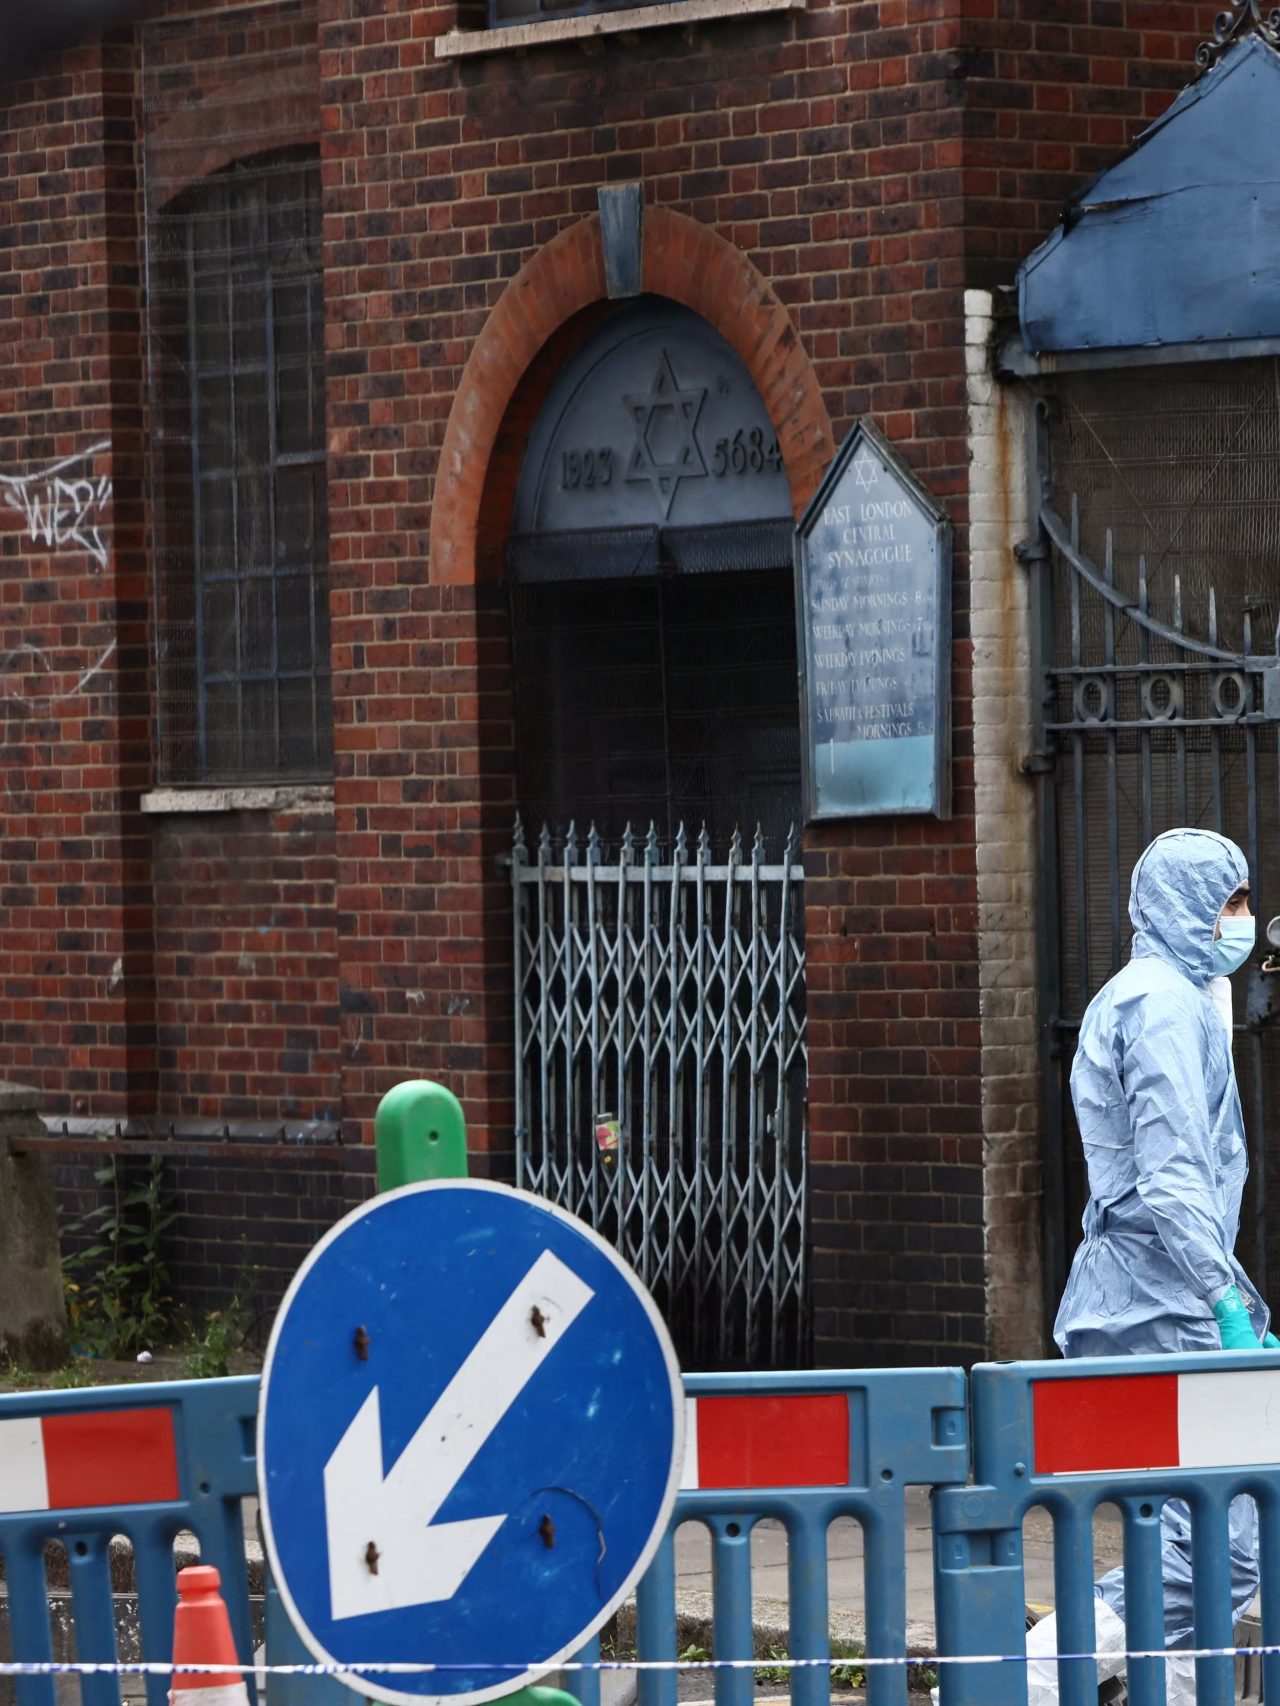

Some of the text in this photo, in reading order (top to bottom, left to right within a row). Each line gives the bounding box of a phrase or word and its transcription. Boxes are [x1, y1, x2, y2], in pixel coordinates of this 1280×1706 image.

[712, 426, 783, 479] 5684
[824, 499, 912, 526] EAST LONDON
[842, 523, 897, 545] CENTRAL
[827, 544, 913, 569] SYNAGOGUE
[811, 595, 849, 612] SUNDAY
[852, 591, 908, 609] MORNINGS
[864, 702, 915, 720] FESTIVALS
